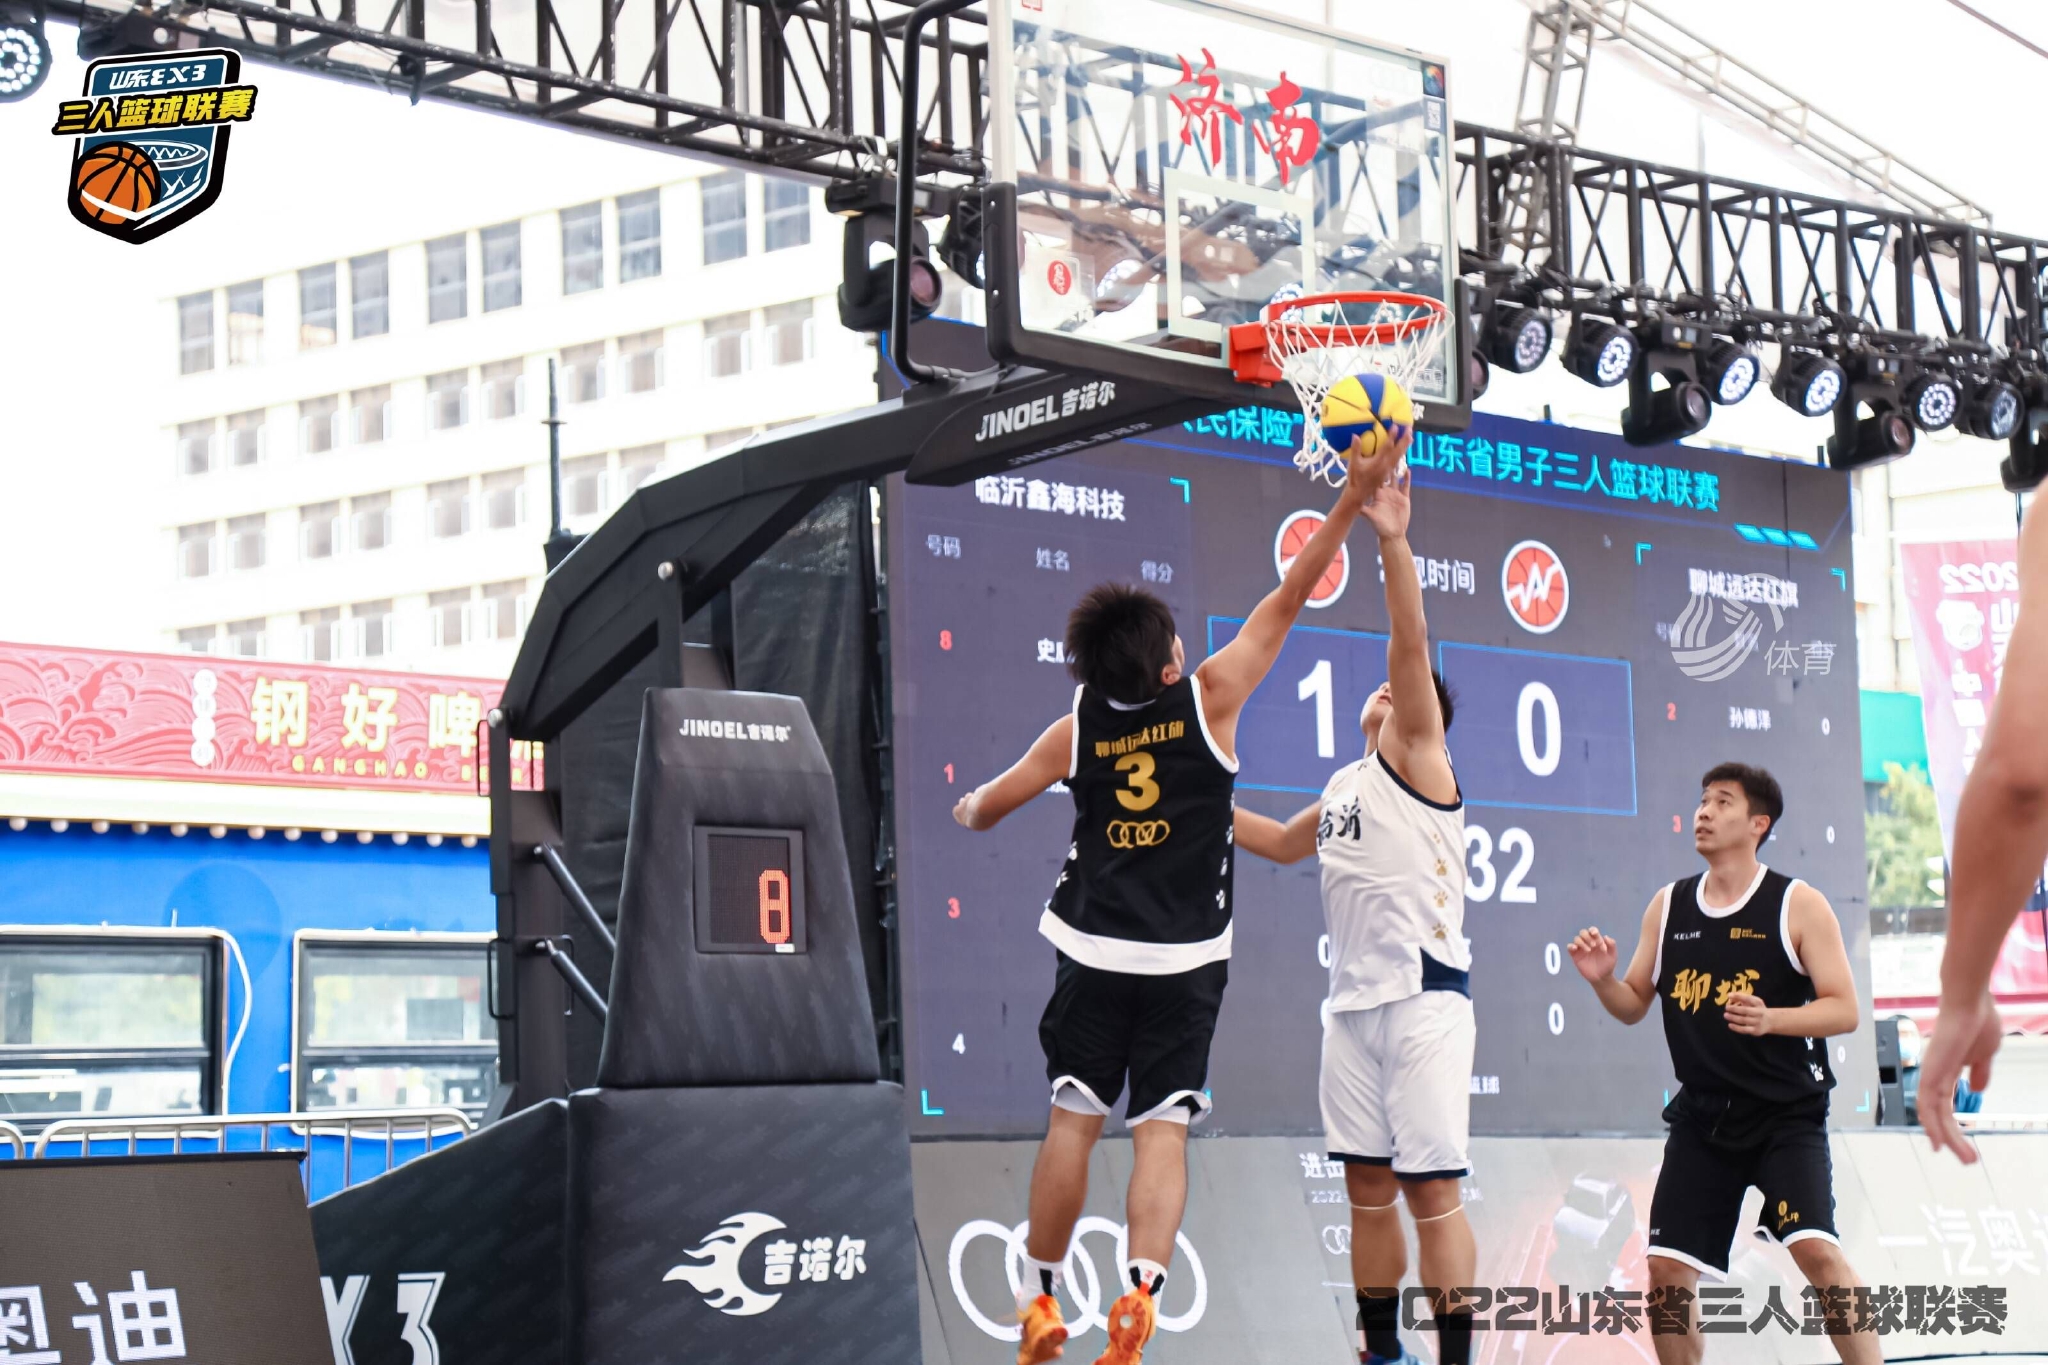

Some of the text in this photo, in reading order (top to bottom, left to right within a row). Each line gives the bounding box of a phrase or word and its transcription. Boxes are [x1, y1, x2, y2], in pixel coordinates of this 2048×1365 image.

[975, 395, 1060, 442] JINOEL
[1061, 381, 1116, 418] 吉诺尔
[1407, 430, 1720, 512] 山东省男子三人篮球联赛
[974, 475, 1126, 522] 临沂鑫海科技
[926, 534, 1174, 584] 号码 姓名 得分
[940, 629, 952, 651] 8
[679, 719, 748, 740] JINOEL
[1298, 659, 1561, 776] 1 0
[1667, 702, 1676, 721] 2
[1821, 717, 1831, 736] 0
[943, 763, 954, 784] 1
[1115, 751, 1160, 811] 3
[1673, 815, 1835, 844] 3 0
[758, 869, 791, 944] 8
[948, 897, 960, 919] 3
[1545, 942, 1561, 975] 0
[1548, 1002, 1565, 1035] 0
[952, 1033, 965, 1054] 4
[764, 1234, 867, 1284] 吉诺尔
